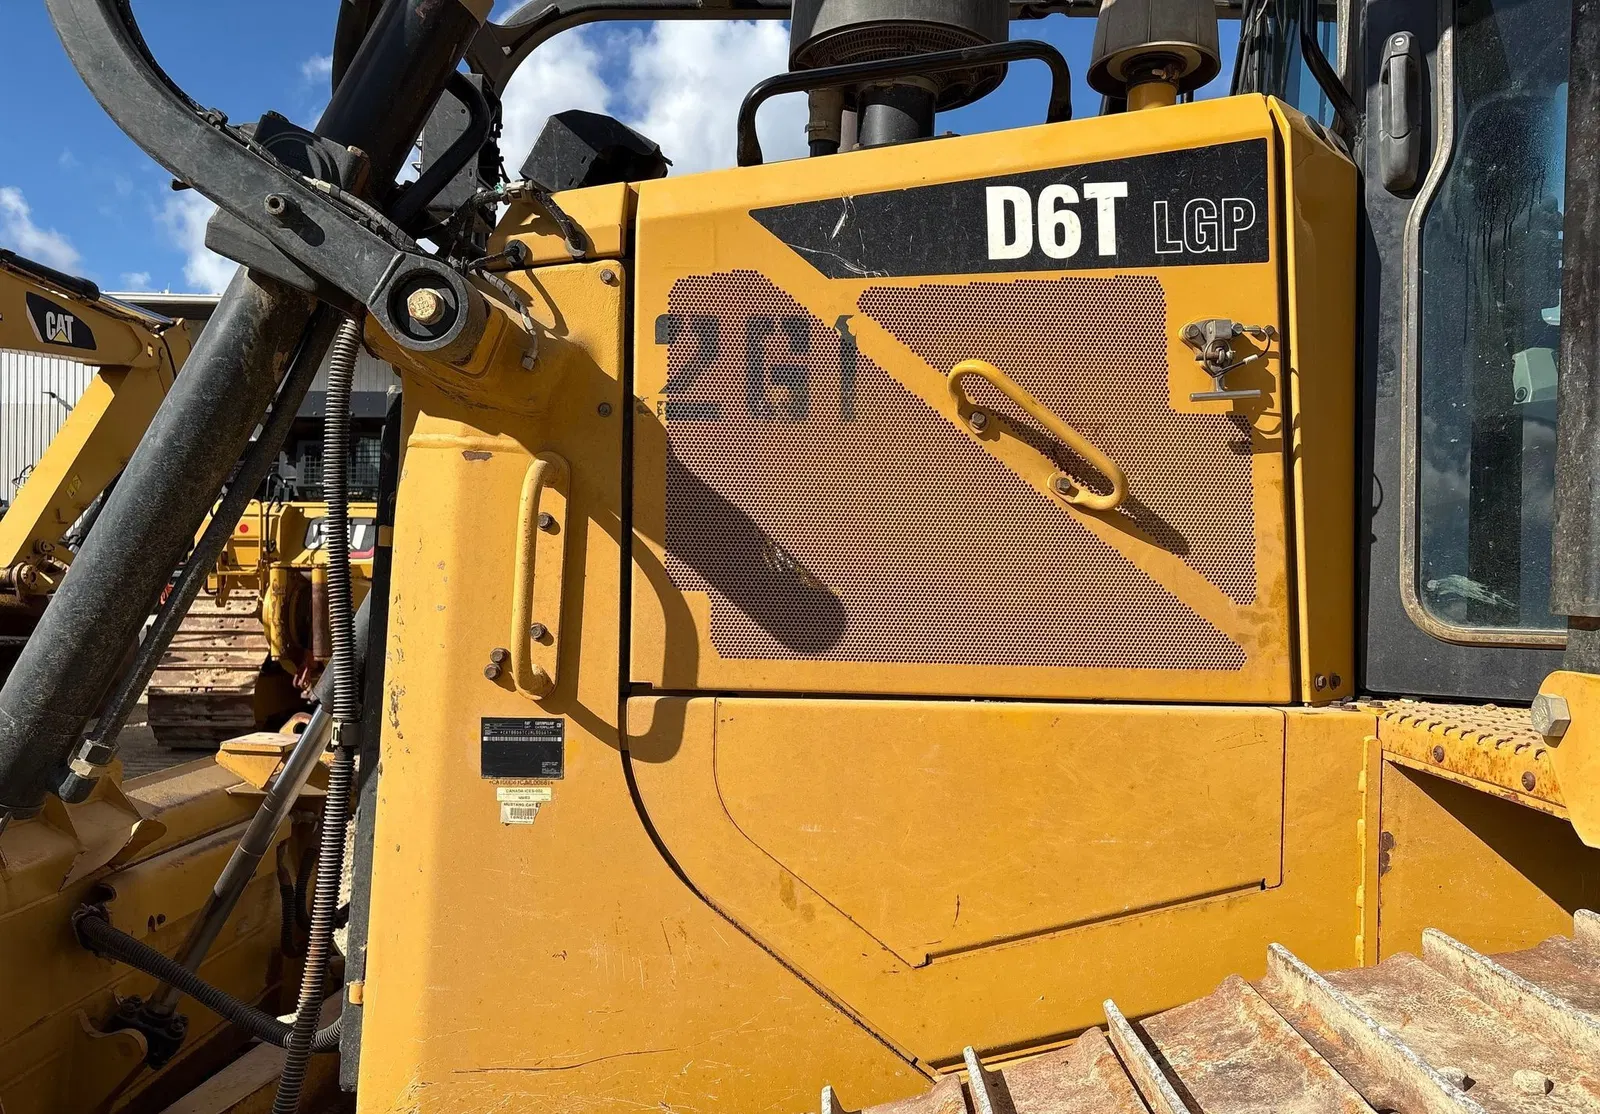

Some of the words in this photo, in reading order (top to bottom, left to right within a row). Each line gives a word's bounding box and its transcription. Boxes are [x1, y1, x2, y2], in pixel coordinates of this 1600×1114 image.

[985, 181, 1128, 260] D6T
[1153, 198, 1256, 254] LGP
[45, 311, 73, 343] CAT
